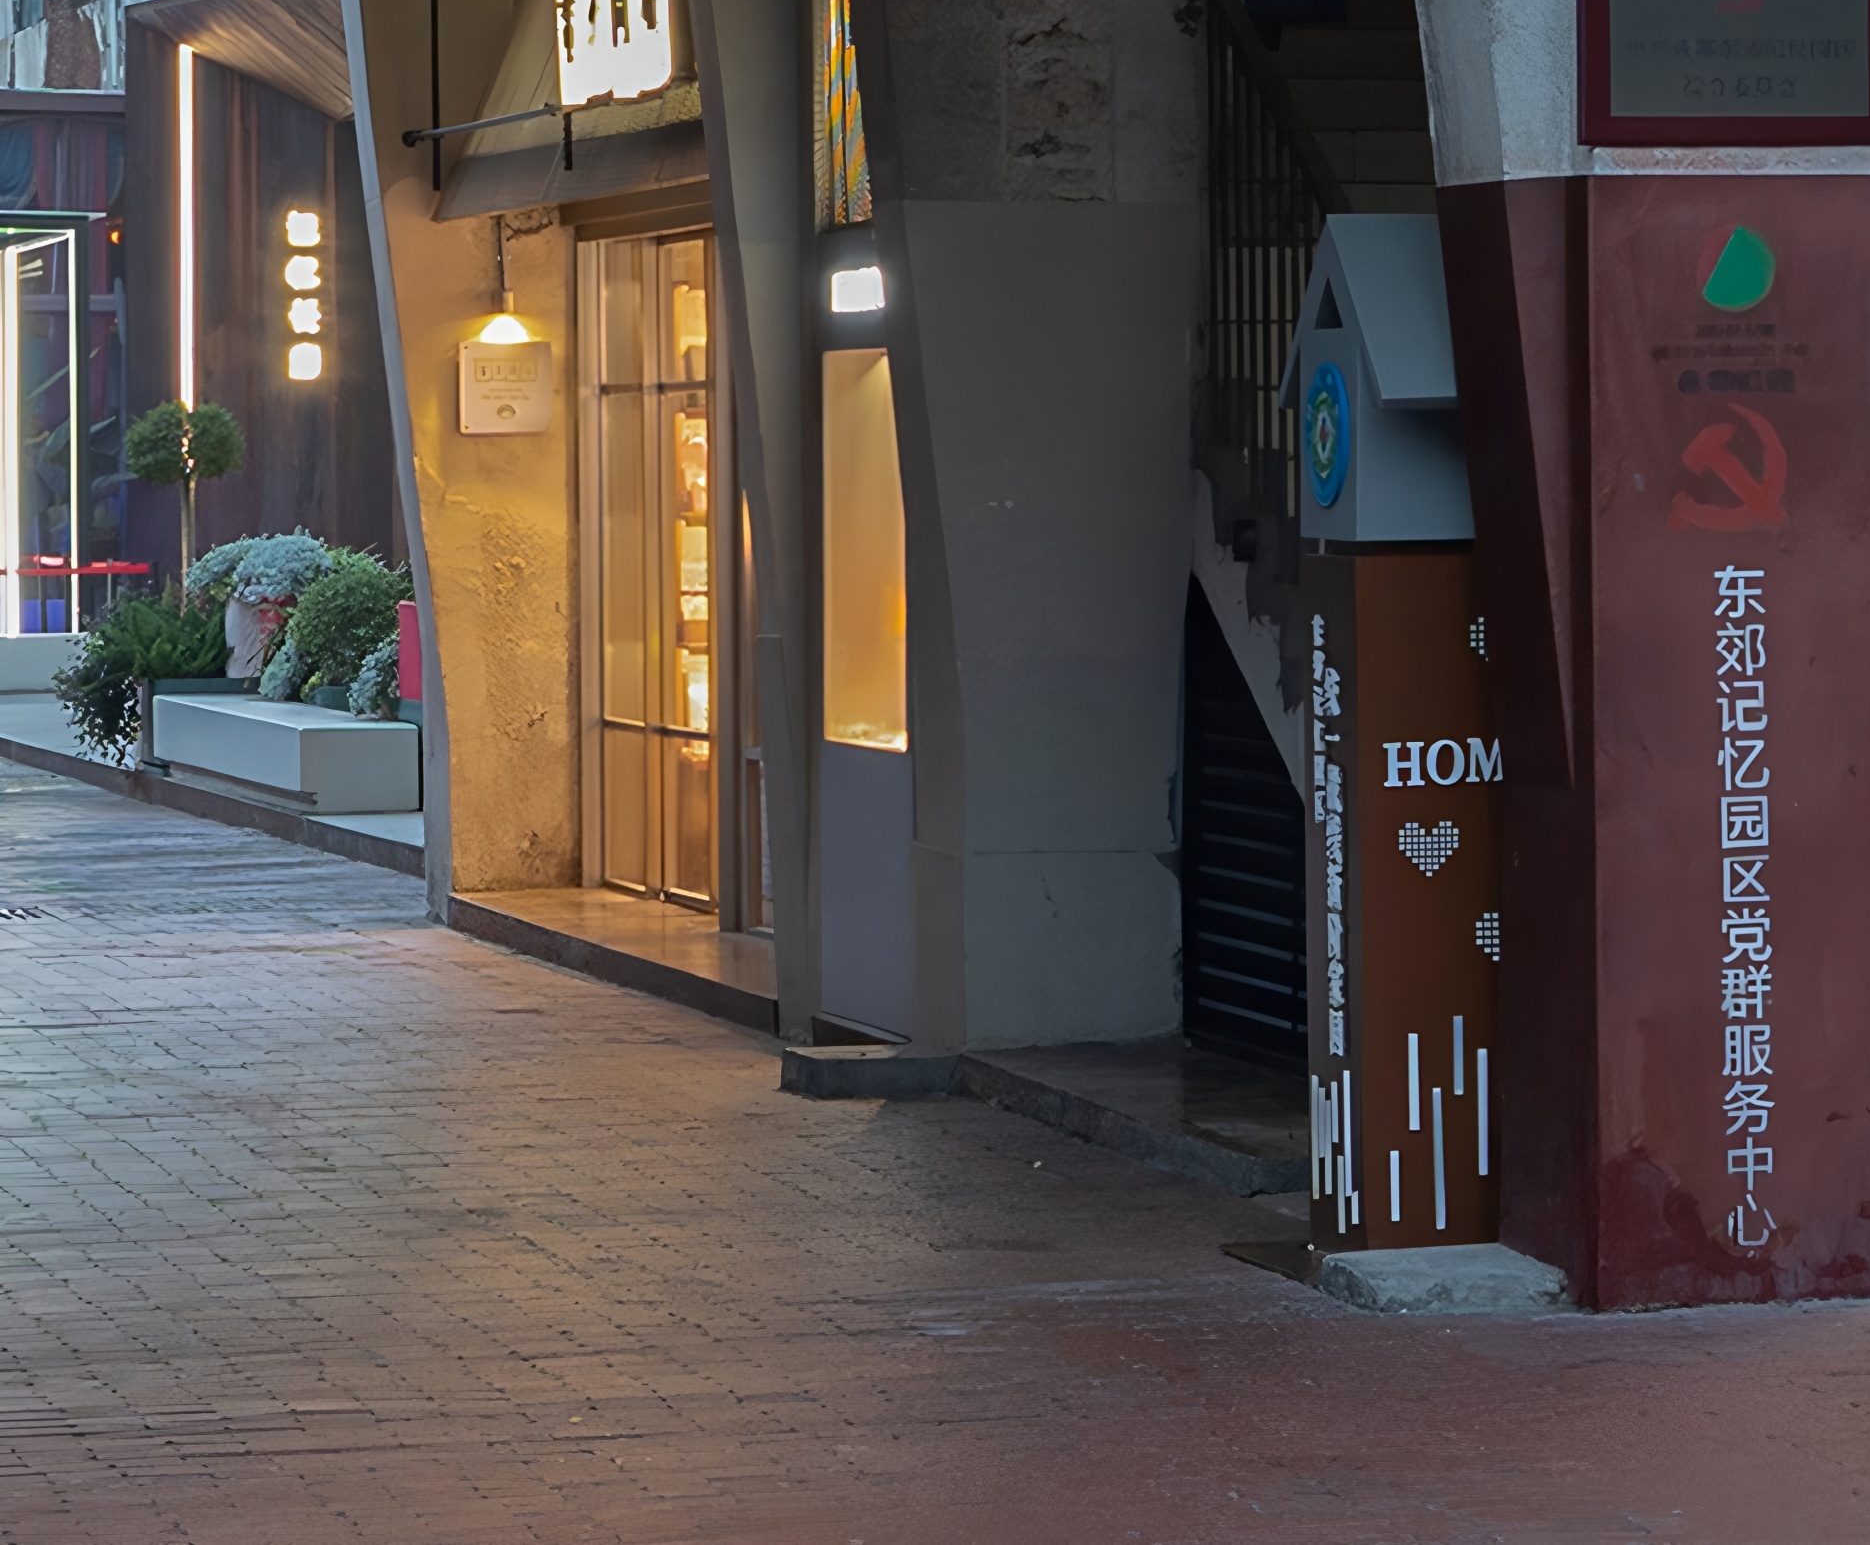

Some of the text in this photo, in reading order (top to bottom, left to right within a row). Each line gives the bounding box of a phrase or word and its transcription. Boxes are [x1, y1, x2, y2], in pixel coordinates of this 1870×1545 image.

[1713, 564, 1778, 1247] 东郊记忆园区党群服务中心
